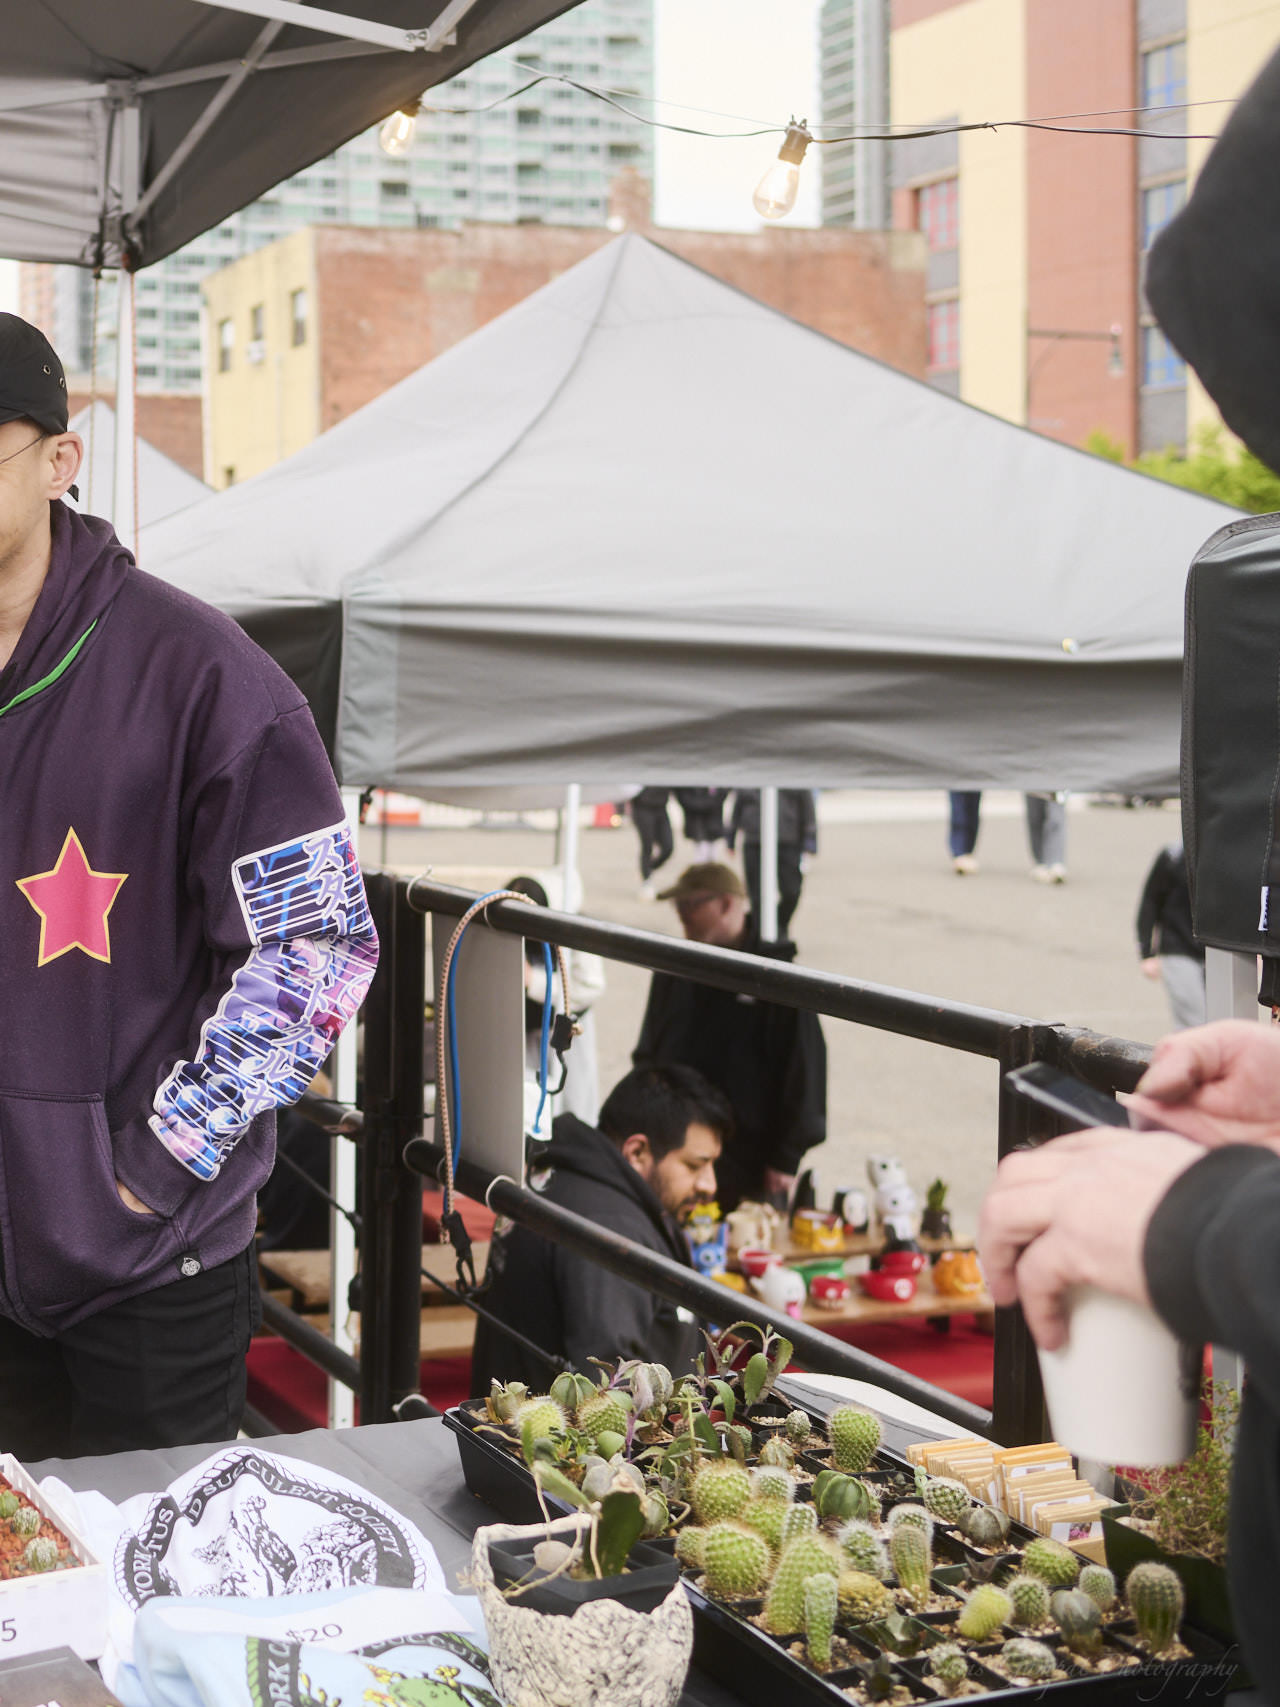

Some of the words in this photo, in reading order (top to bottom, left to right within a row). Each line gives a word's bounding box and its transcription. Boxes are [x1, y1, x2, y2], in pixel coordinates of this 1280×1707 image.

[202, 1458, 339, 1504] SUCCULENT
[148, 1507, 174, 1558] TUS
[335, 1502, 403, 1557] SOCIETY
[285, 1623, 343, 1643] $20
